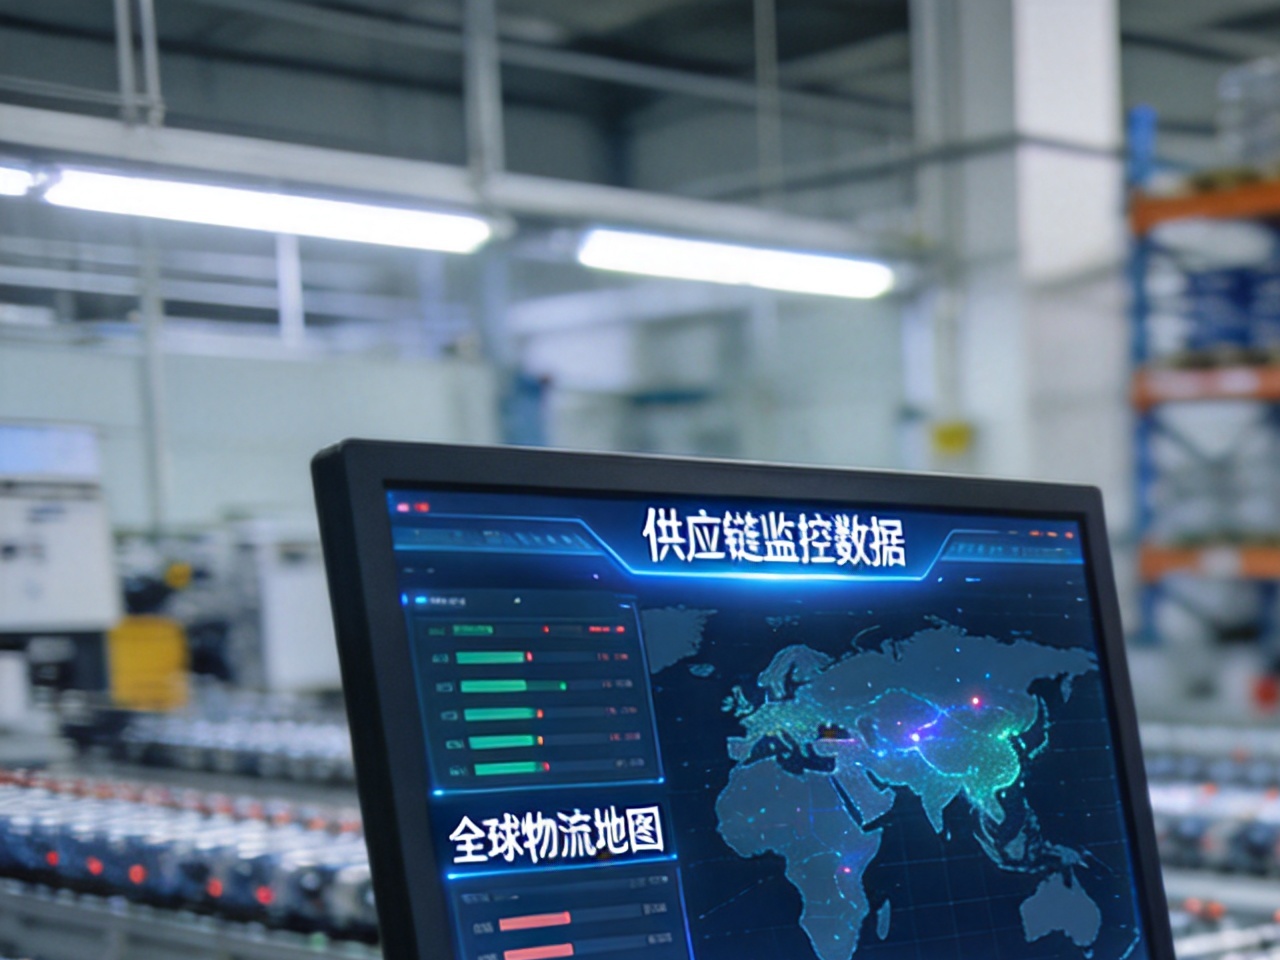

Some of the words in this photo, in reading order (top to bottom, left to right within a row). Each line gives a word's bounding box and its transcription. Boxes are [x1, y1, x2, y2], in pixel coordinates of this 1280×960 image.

[642, 507, 907, 568] 供应链监控数据
[448, 805, 665, 864] 全球物流地图
